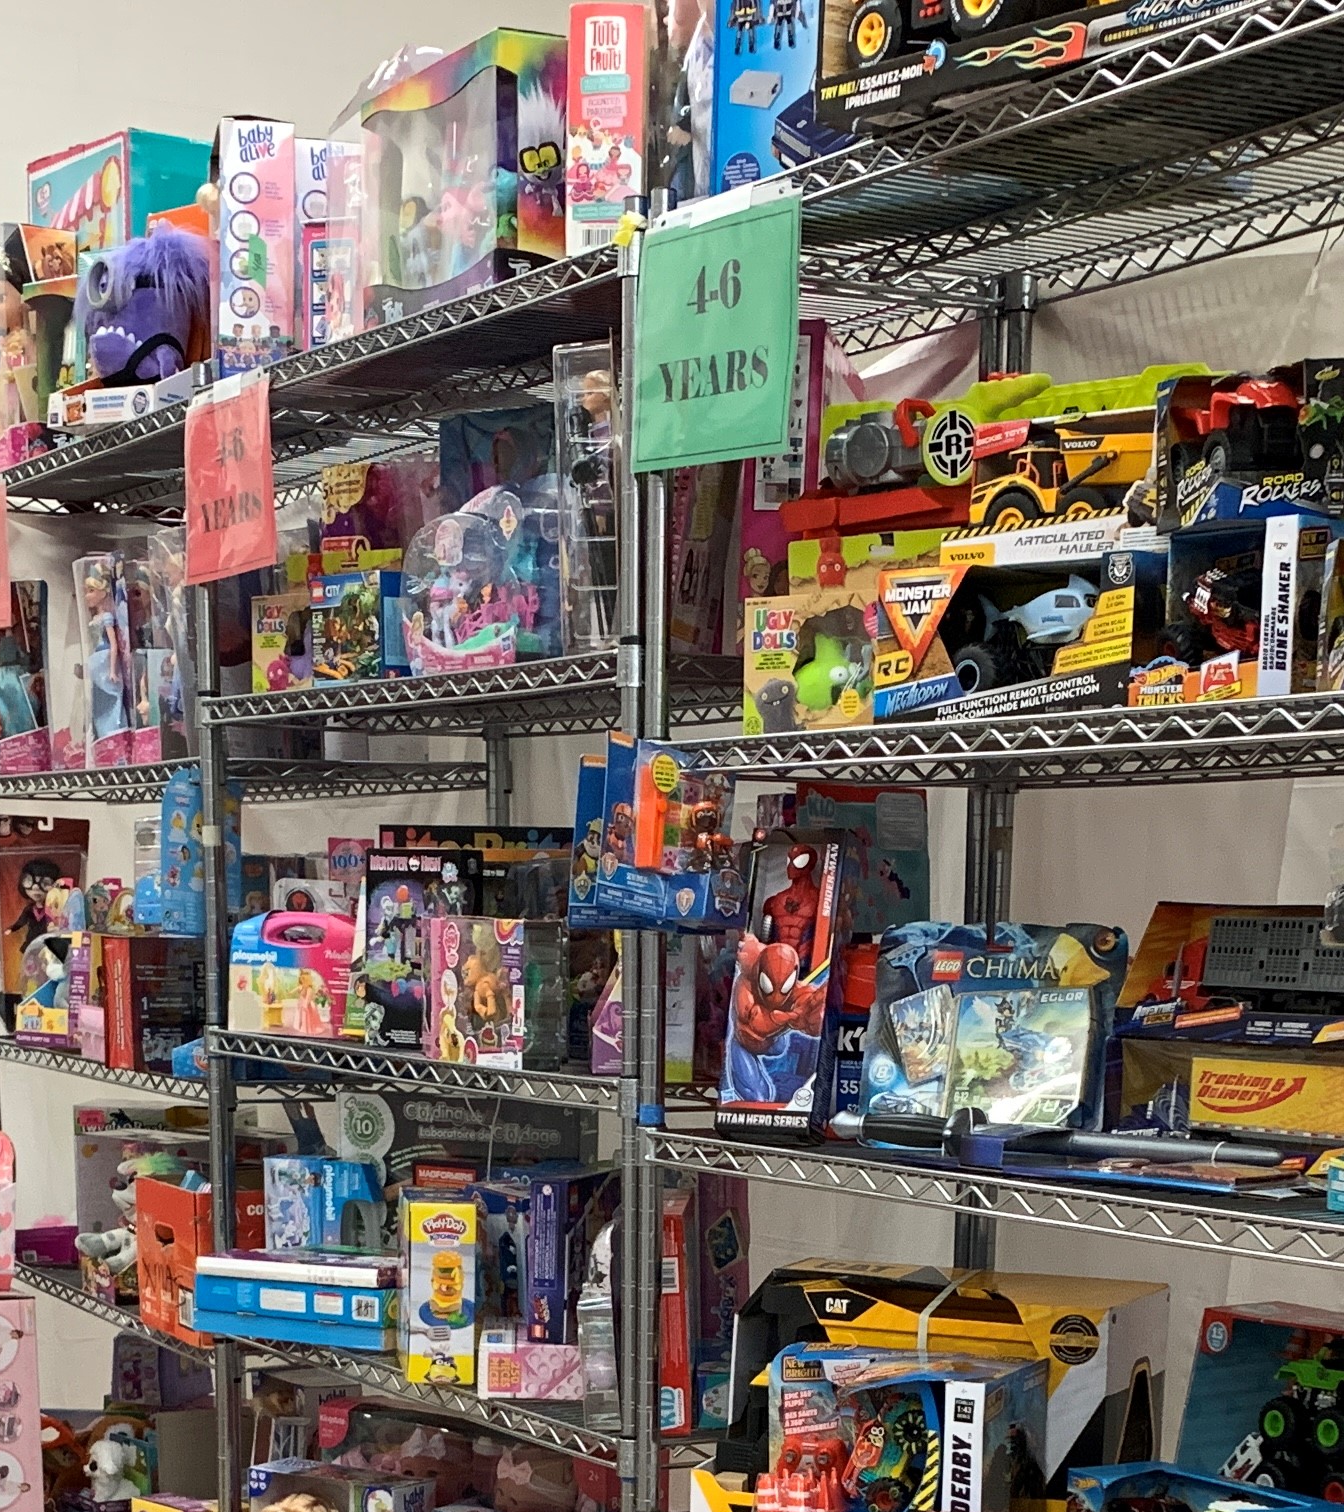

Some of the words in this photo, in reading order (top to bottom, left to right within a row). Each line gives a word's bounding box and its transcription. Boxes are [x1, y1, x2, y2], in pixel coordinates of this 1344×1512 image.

[237, 124, 274, 147] baby
[240, 140, 275, 164] alive
[686, 258, 742, 315] 4-6
[658, 345, 769, 403] YEARS
[1063, 439, 1098, 450] VOLVO
[1261, 472, 1305, 486] ROAD
[1239, 478, 1323, 512] ROCKERS
[1014, 529, 1106, 547] ARTICULATED
[949, 551, 985, 562] VOLVO
[1058, 541, 1115, 555] HAULER
[884, 584, 952, 603] MONSTER
[1277, 560, 1292, 617] SHAKER
[901, 600, 933, 616] JAM
[754, 608, 795, 630] UGLY
[752, 629, 797, 652] DOLLS
[1274, 618, 1287, 671] BONE
[877, 656, 910, 677] RC
[937, 702, 958, 717] FULL
[959, 692, 1008, 713] FUNCTION
[1009, 683, 1051, 702] REMOTE
[1051, 672, 1097, 693] CONTROL
[1020, 682, 1100, 710] MULTIFONCTION
[1138, 684, 1184, 695] MONSTER
[369, 855, 409, 872] MONSTER
[420, 855, 442, 872] HIGH
[822, 843, 840, 918] SPIDER-MAN
[231, 950, 278, 965] playmobil
[933, 959, 961, 973] LEGO
[1040, 990, 1084, 1003] EGLOR
[716, 1111, 745, 1127] TITAN
[745, 1112, 772, 1127] HERO
[773, 1114, 809, 1129] SERIES
[416, 1167, 476, 1183] MAGFORMERS
[322, 1163, 335, 1222] playmobil
[824, 1297, 850, 1315] CAT
